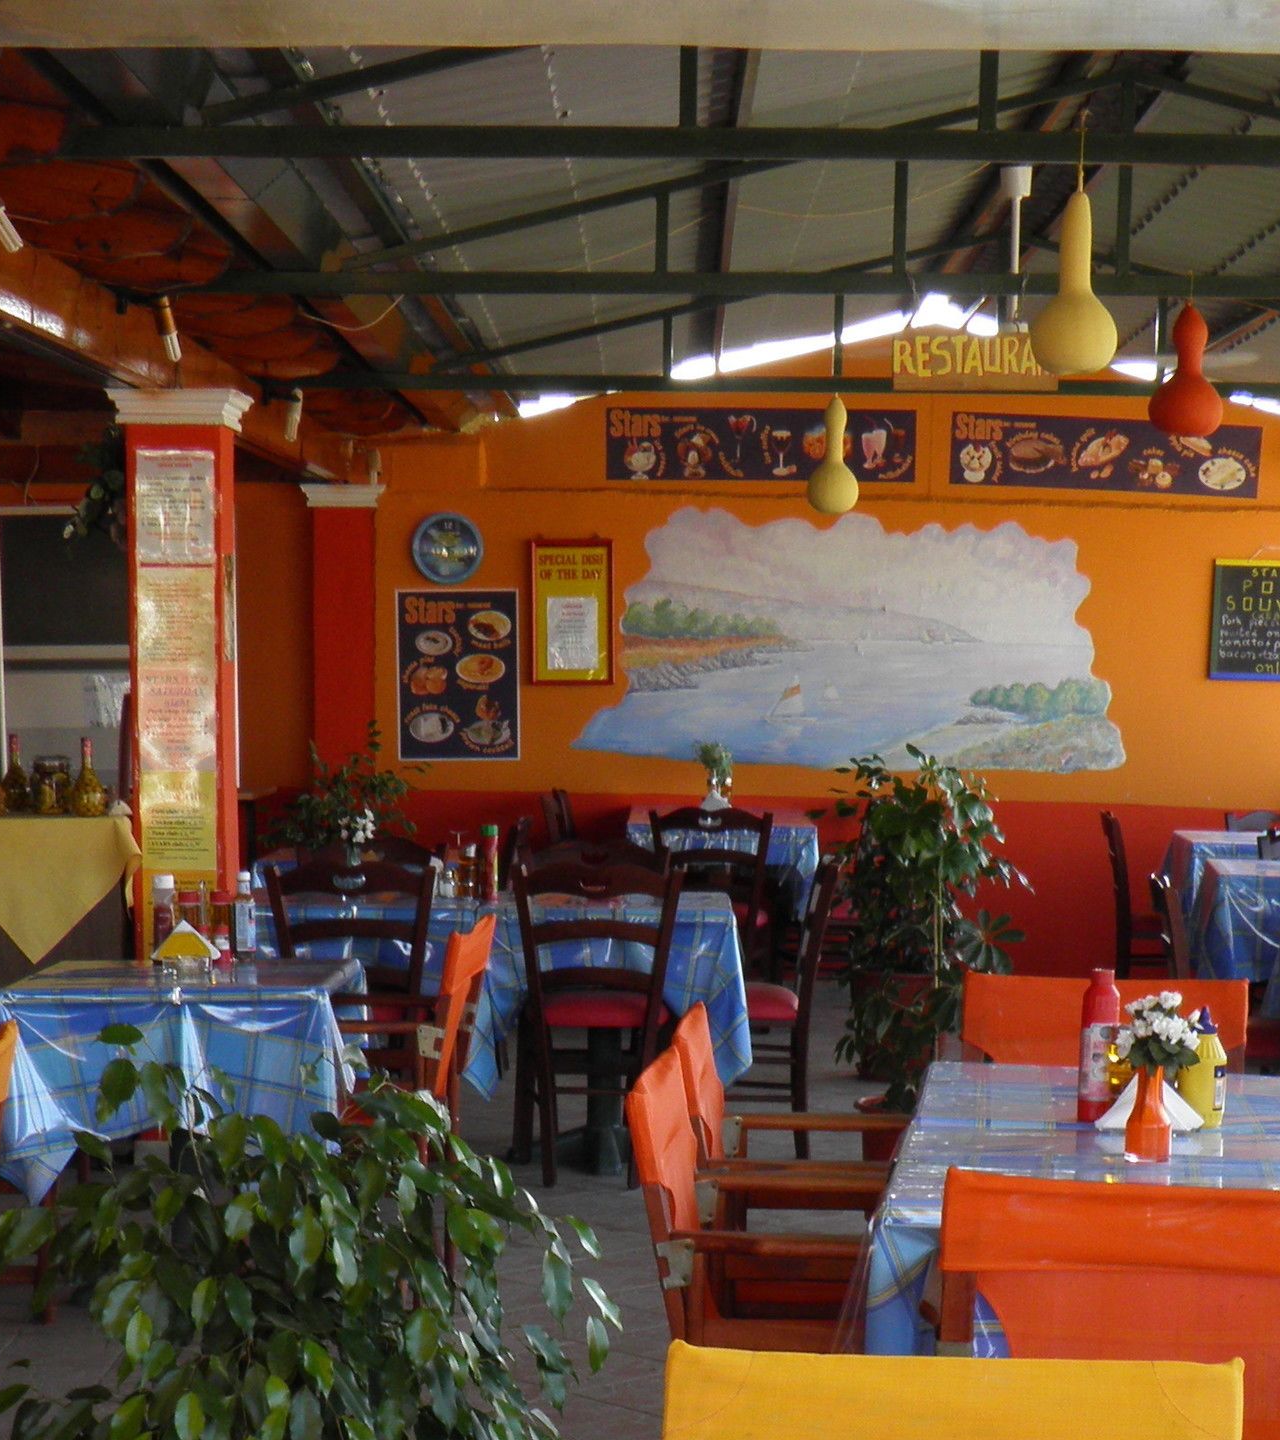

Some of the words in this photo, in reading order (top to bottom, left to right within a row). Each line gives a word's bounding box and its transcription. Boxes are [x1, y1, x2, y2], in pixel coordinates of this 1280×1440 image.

[610, 409, 662, 438] Stars
[955, 413, 1003, 441] Stars
[539, 554, 576, 566] SPECIAL
[540, 569, 552, 580] OF
[557, 569, 576, 580] THE
[581, 569, 601, 580] DAY
[404, 596, 456, 625] Stars
[1219, 648, 1256, 660] bacon
